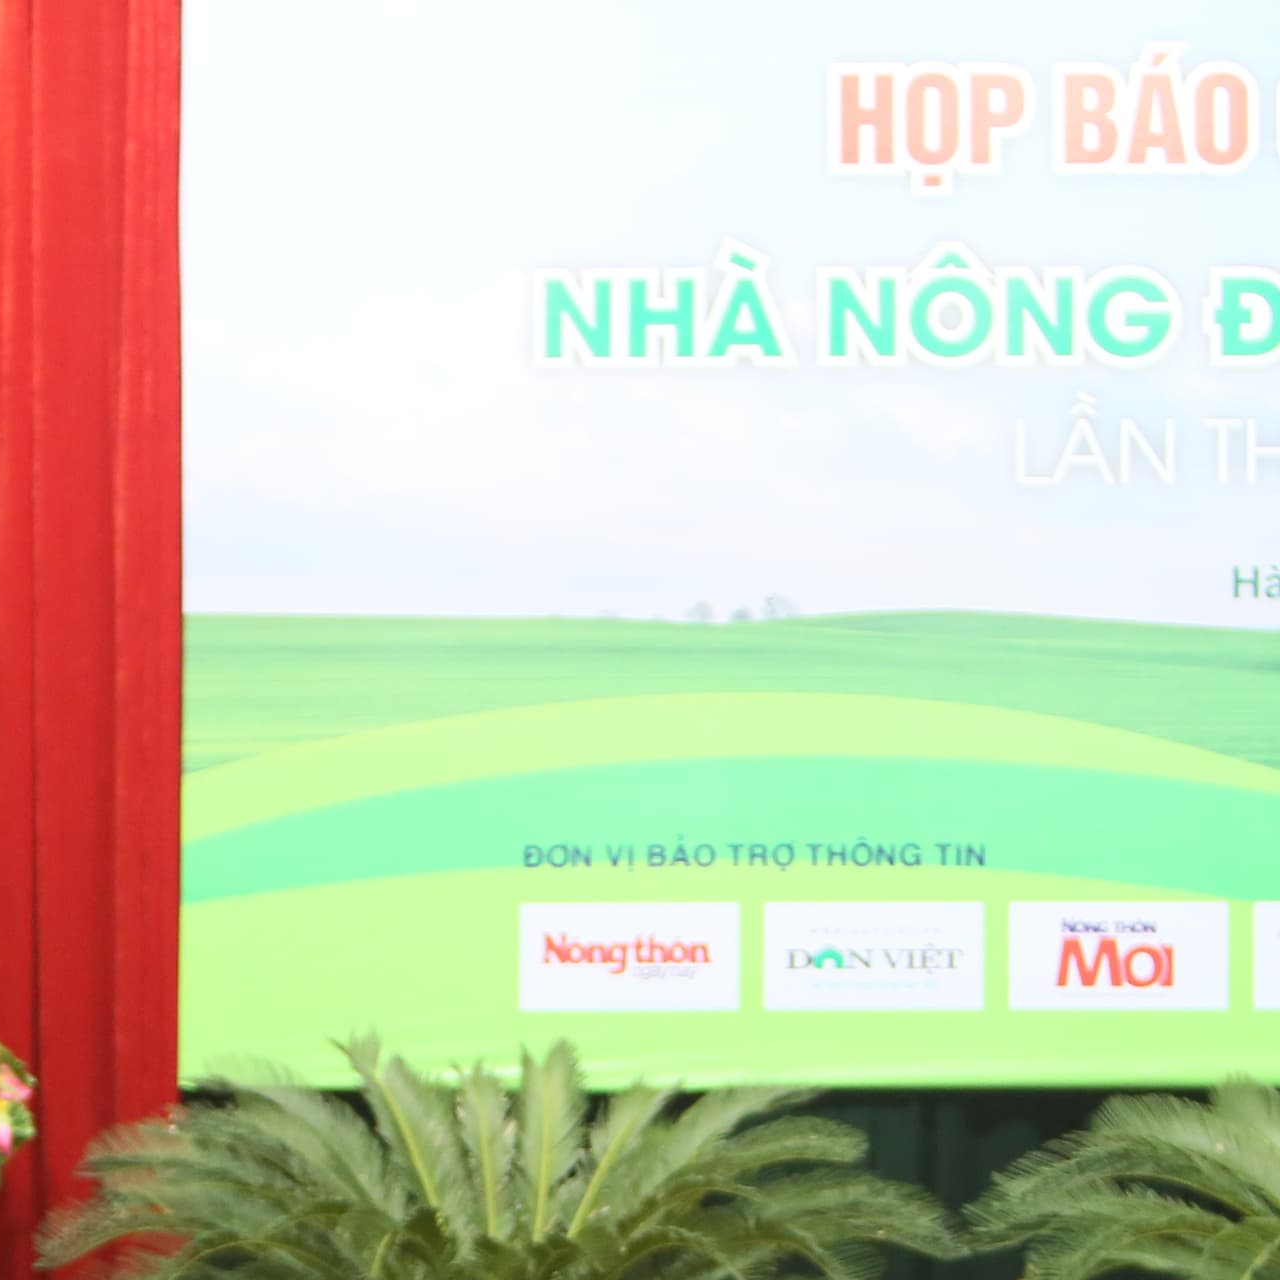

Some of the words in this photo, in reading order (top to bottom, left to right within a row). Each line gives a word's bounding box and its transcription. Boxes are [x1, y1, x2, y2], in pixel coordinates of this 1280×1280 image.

[837, 71, 1028, 188] HỌP
[1061, 50, 1252, 167] BÁO
[540, 250, 786, 360] NHÀ
[827, 250, 1175, 360] NÔNG
[1014, 391, 1177, 487] LẦN
[934, 844, 988, 868] TIN
